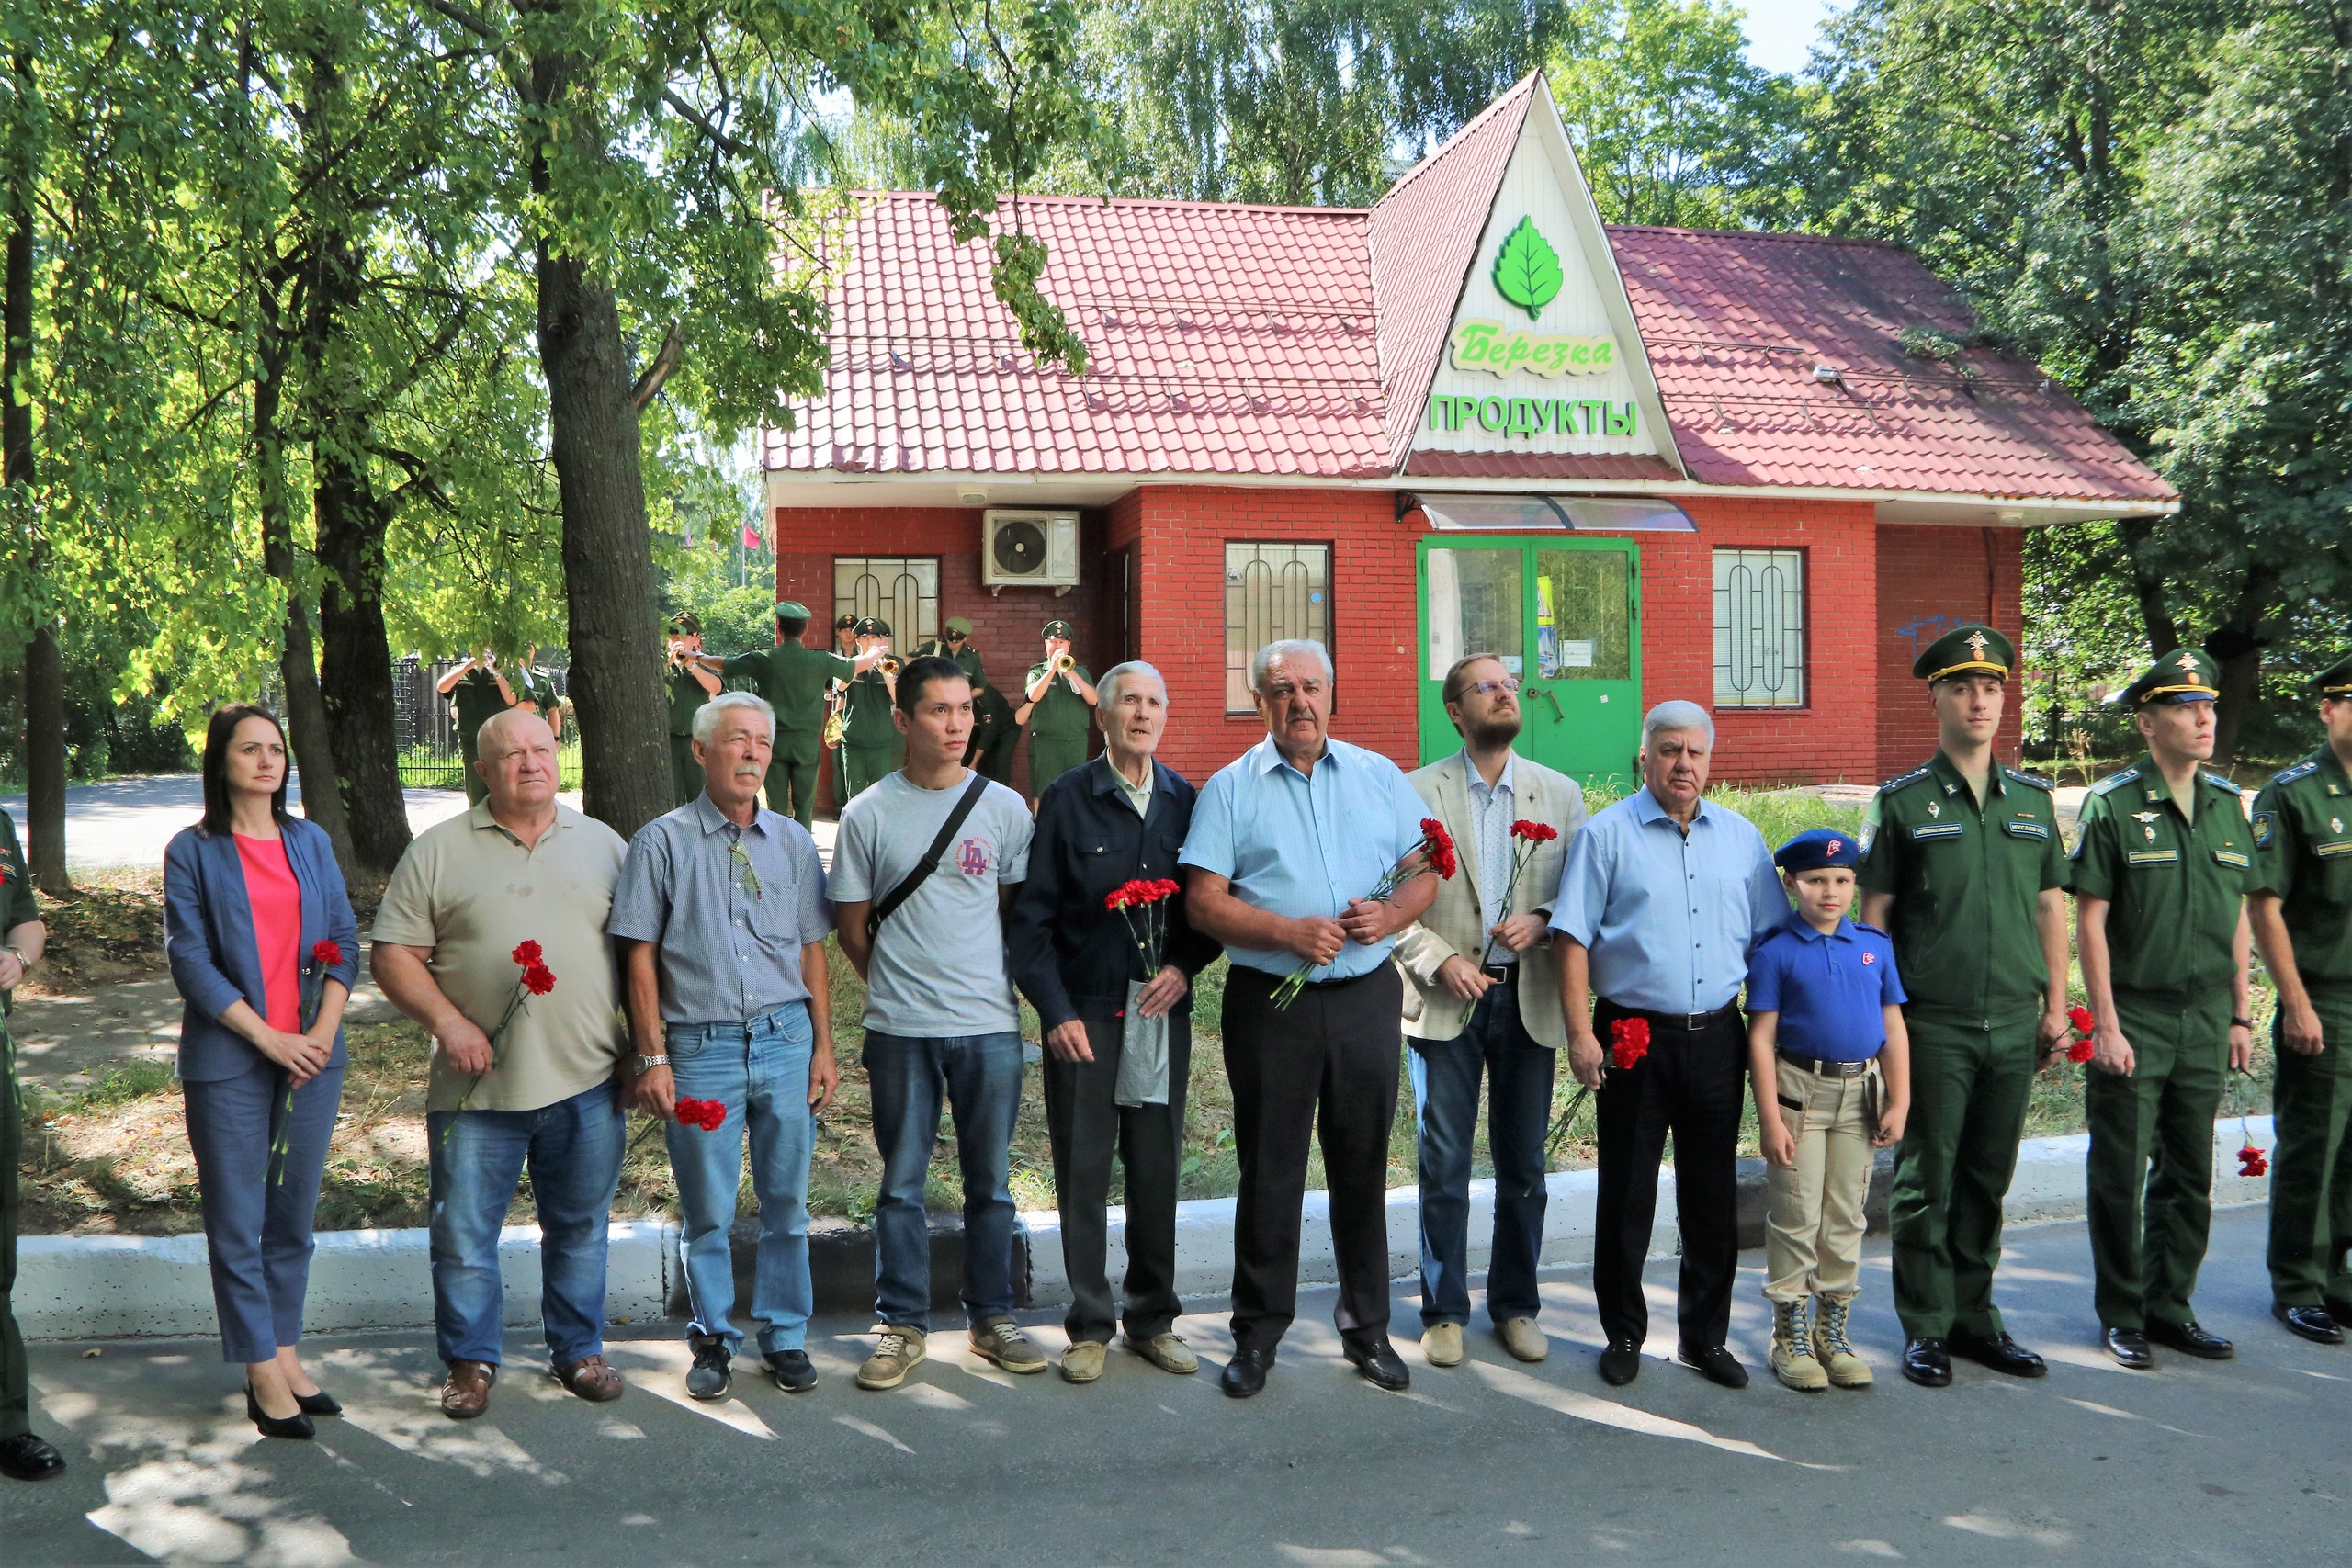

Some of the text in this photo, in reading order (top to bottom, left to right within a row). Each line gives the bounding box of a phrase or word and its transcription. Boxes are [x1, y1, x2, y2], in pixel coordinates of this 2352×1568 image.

[1458, 323, 1612, 371] Березка
[1430, 395, 1637, 439] ПРОДУКТЫ
[962, 840, 987, 876] LA
